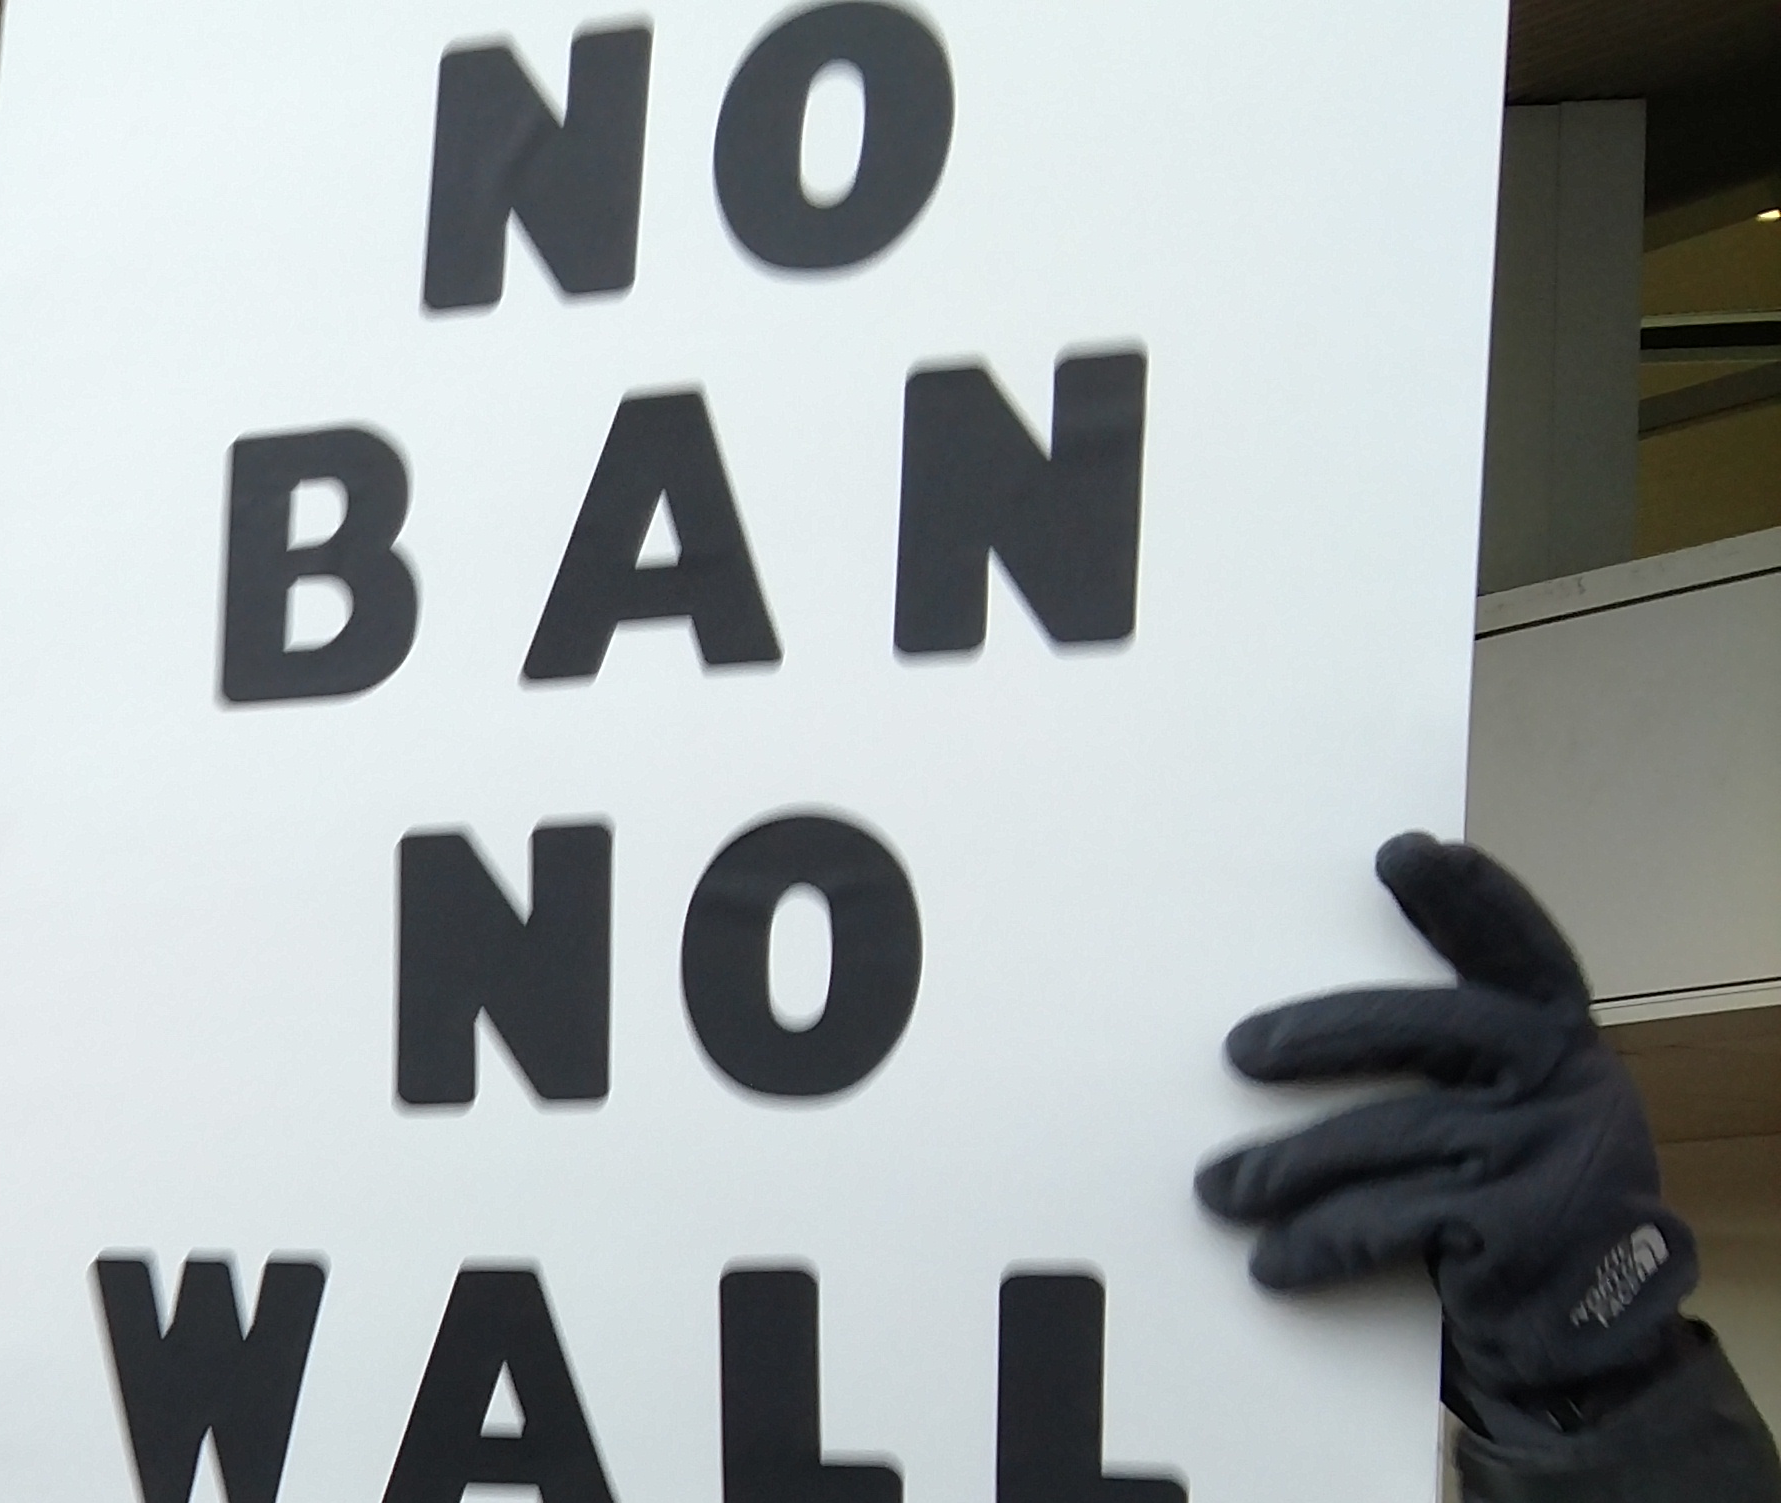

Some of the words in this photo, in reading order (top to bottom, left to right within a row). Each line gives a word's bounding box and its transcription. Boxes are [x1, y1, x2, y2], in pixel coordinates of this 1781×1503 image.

[423, 0, 955, 313] NO
[219, 347, 1148, 705] BAN
[395, 812, 924, 1108] NO
